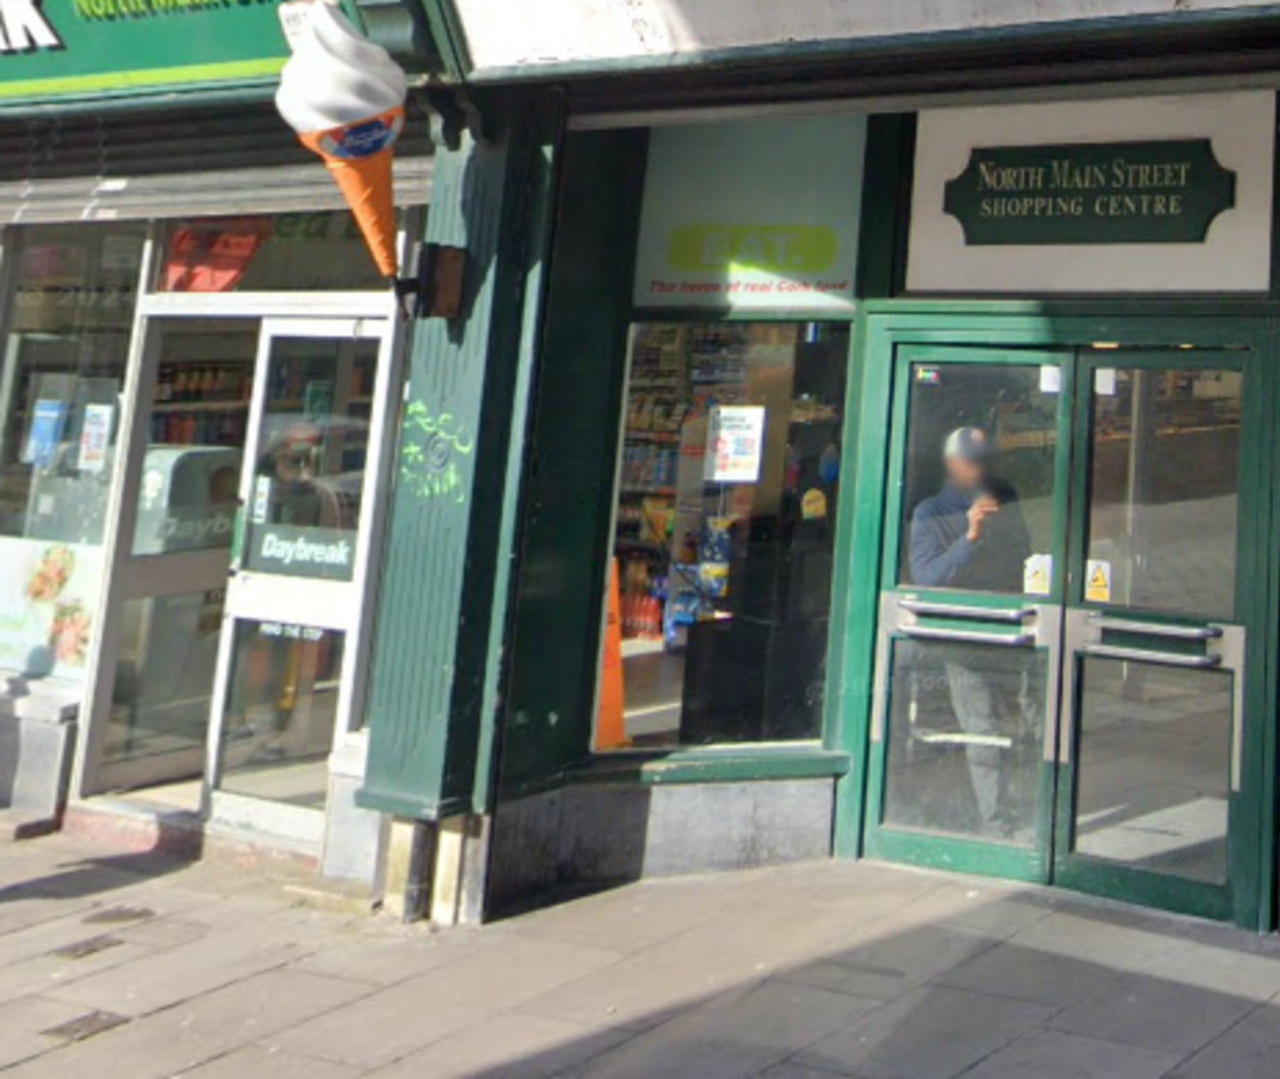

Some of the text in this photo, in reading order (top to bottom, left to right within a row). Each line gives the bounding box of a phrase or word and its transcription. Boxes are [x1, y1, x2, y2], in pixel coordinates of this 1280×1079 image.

[978, 158, 1192, 191] NORTH MAIN STREET
[979, 194, 1183, 218] SHOPPING CENTRE
[261, 532, 349, 565] Daybreak
